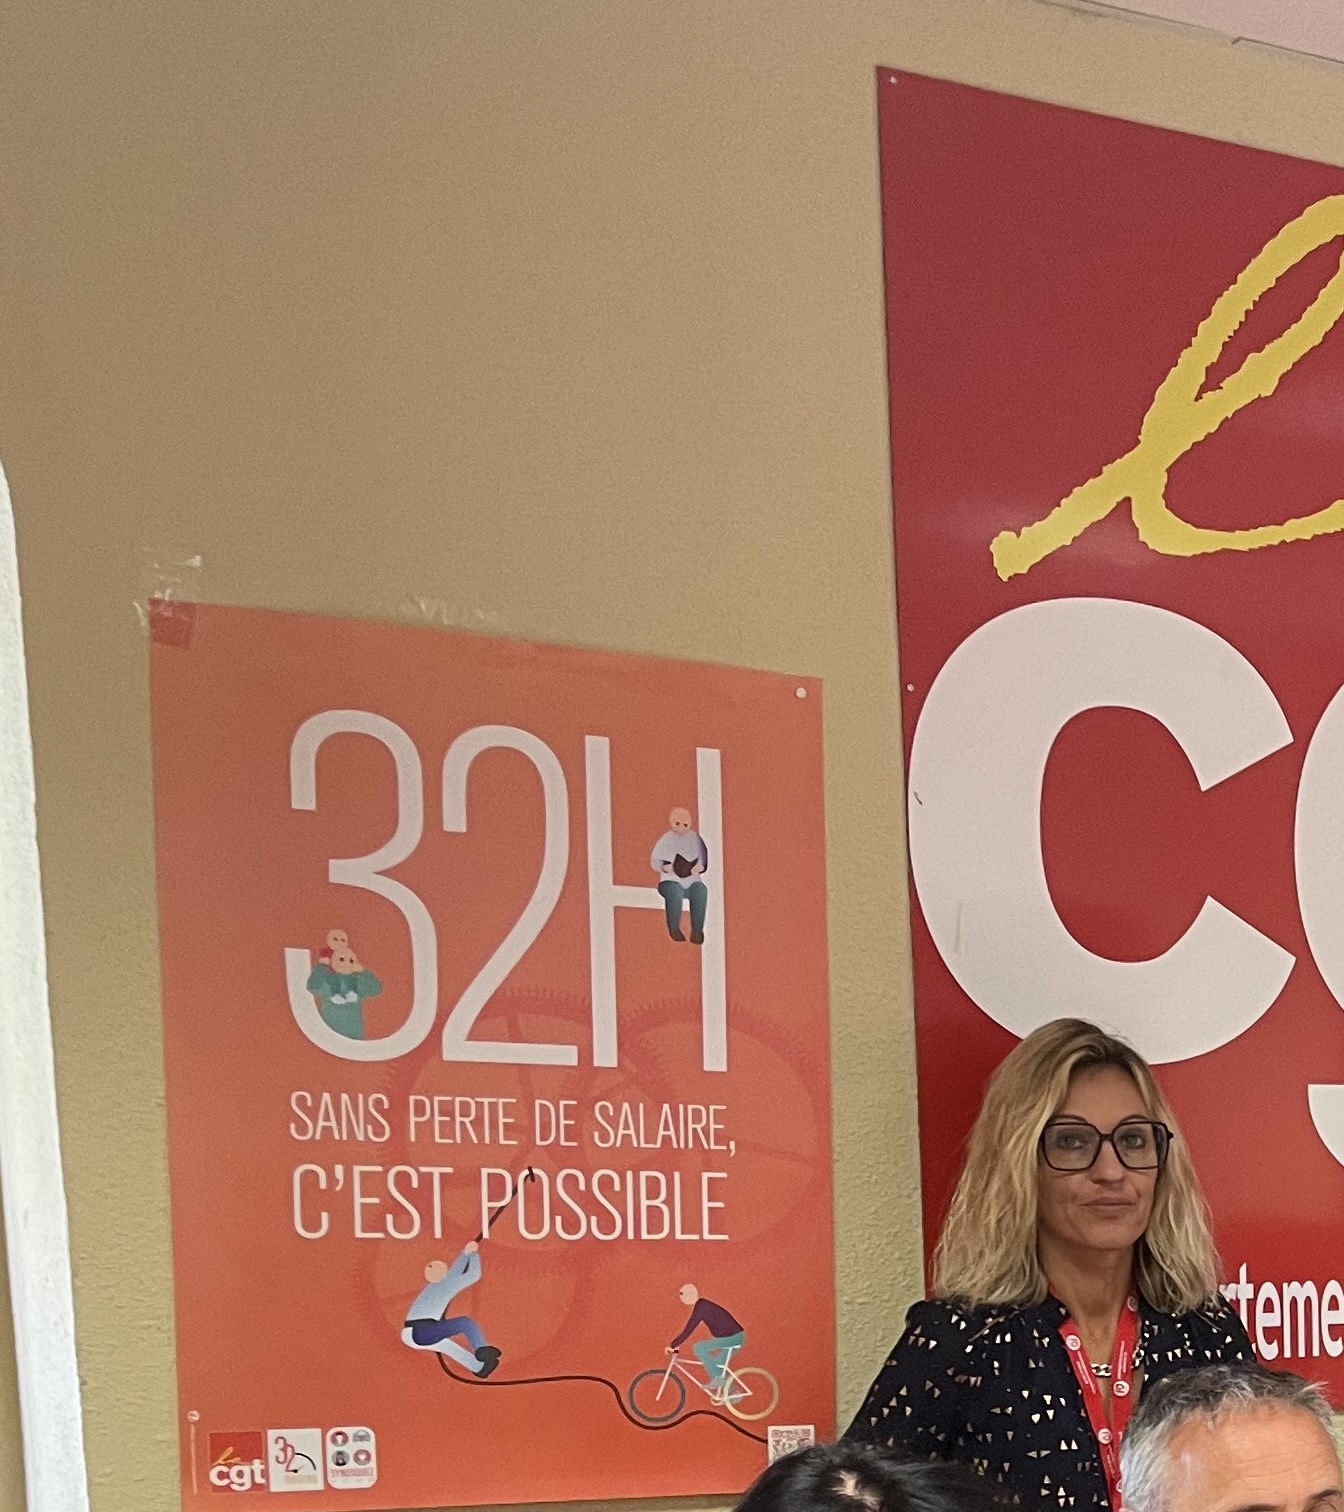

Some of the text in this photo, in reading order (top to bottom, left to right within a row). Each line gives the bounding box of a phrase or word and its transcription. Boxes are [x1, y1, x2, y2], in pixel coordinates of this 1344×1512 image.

[284, 709, 727, 1072] 32H
[290, 1091, 737, 1157] SANS PERTE DE SALAIRE,
[292, 1164, 729, 1241] C'EST POSSIBLE
[208, 1458, 267, 1492] cgt
